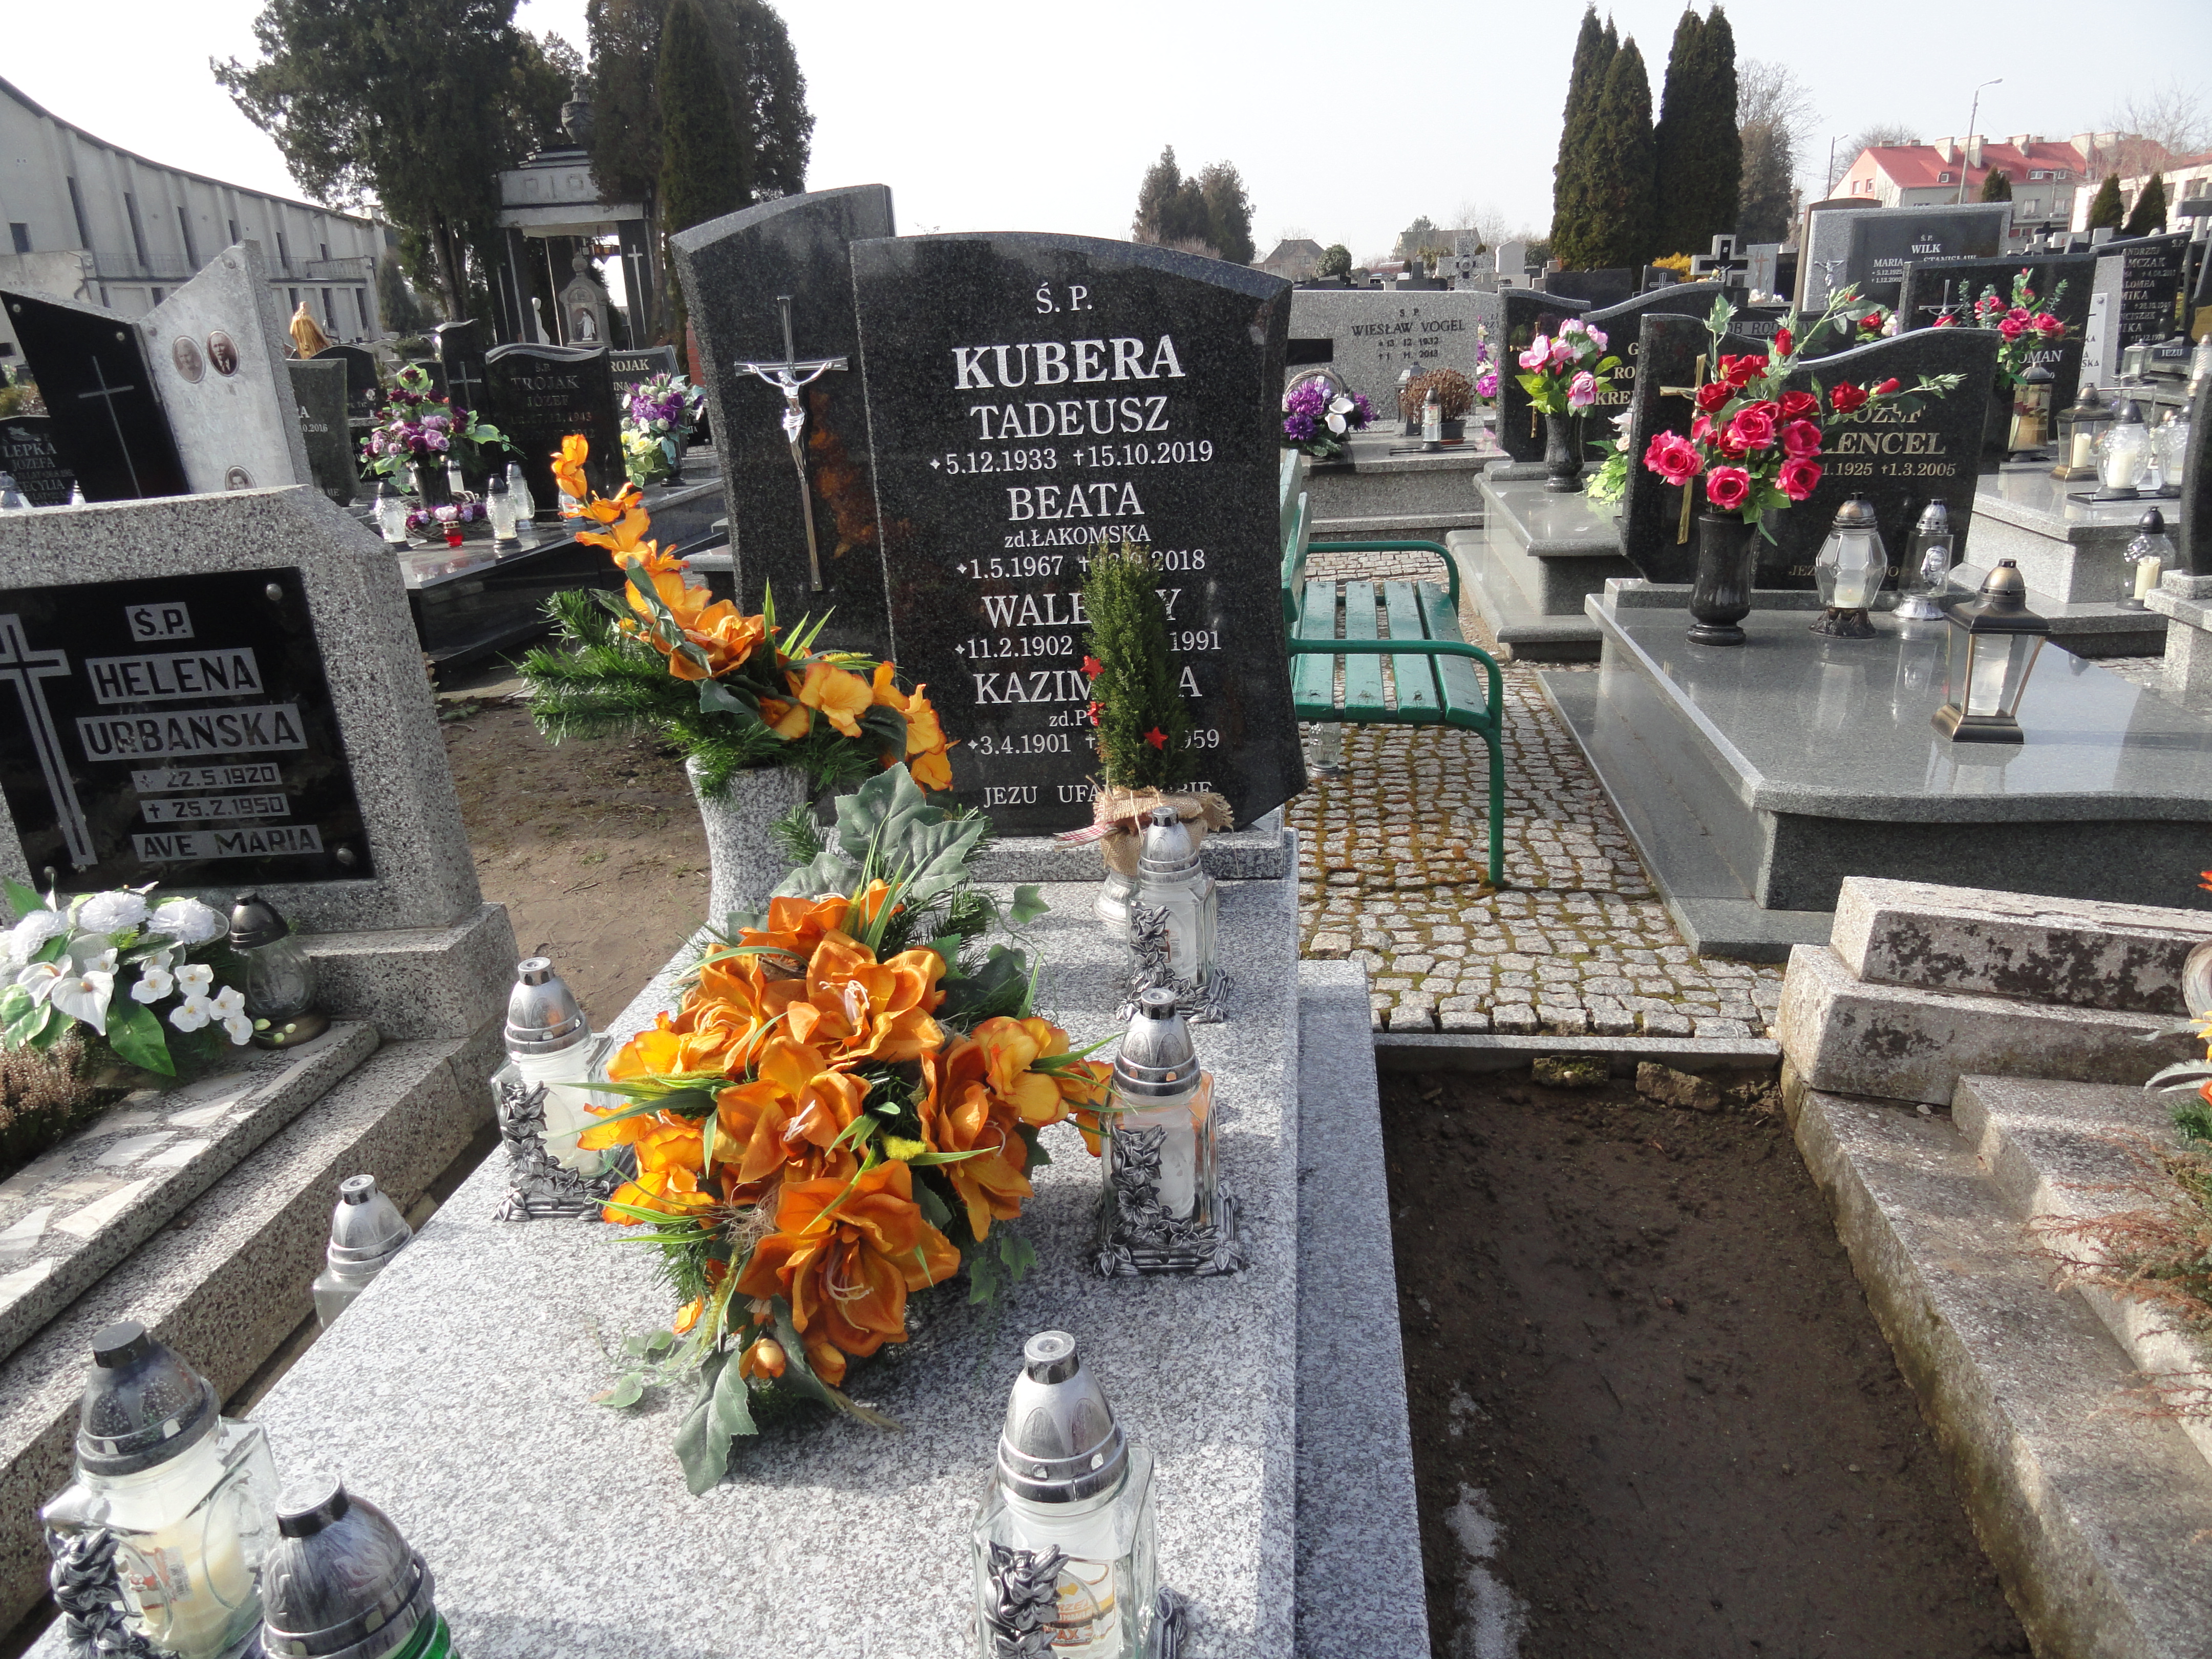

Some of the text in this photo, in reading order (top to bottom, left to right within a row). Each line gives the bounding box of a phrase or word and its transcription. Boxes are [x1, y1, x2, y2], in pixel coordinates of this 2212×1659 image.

[1911, 244, 1941, 254] WILK
[1873, 258, 1903, 267] MARIA
[1036, 282, 1092, 314] Ś. P.
[1351, 320, 1466, 336] WIESŁAW VOGEL
[952, 334, 1186, 390] KUBERA
[2081, 359, 2099, 368] SKA
[2161, 349, 2183, 357] JEZU
[610, 359, 650, 372] ROJAK
[1613, 366, 1636, 379] RO
[511, 375, 580, 390] TROJAK
[1594, 391, 1634, 406] KRE
[301, 423, 328, 432] 0.2016
[970, 396, 1170, 440] TADEUSZ
[1822, 432, 1946, 455] ENCEL
[946, 440, 1213, 475] 5.12.1933 15.10.2019
[1821, 462, 1873, 476] 1.1925
[1007, 482, 1145, 521] BEATA
[1005, 524, 1151, 548] zd.ŁAKOMSKA
[970, 555, 1064, 579] 1.5.1967
[1788, 565, 1816, 576] JEZ
[981, 588, 1182, 629] WALEY
[967, 635, 1073, 659] 11.2.1902
[93, 653, 258, 699] HELENA
[972, 665, 1203, 705] KAZIMA
[980, 734, 1072, 755] 3.4.1901
[167, 767, 276, 789] 22.5.1920
[173, 797, 285, 818] 25.2.1950
[983, 786, 1038, 809] JEZU
[143, 828, 318, 858] AVE MARIA
